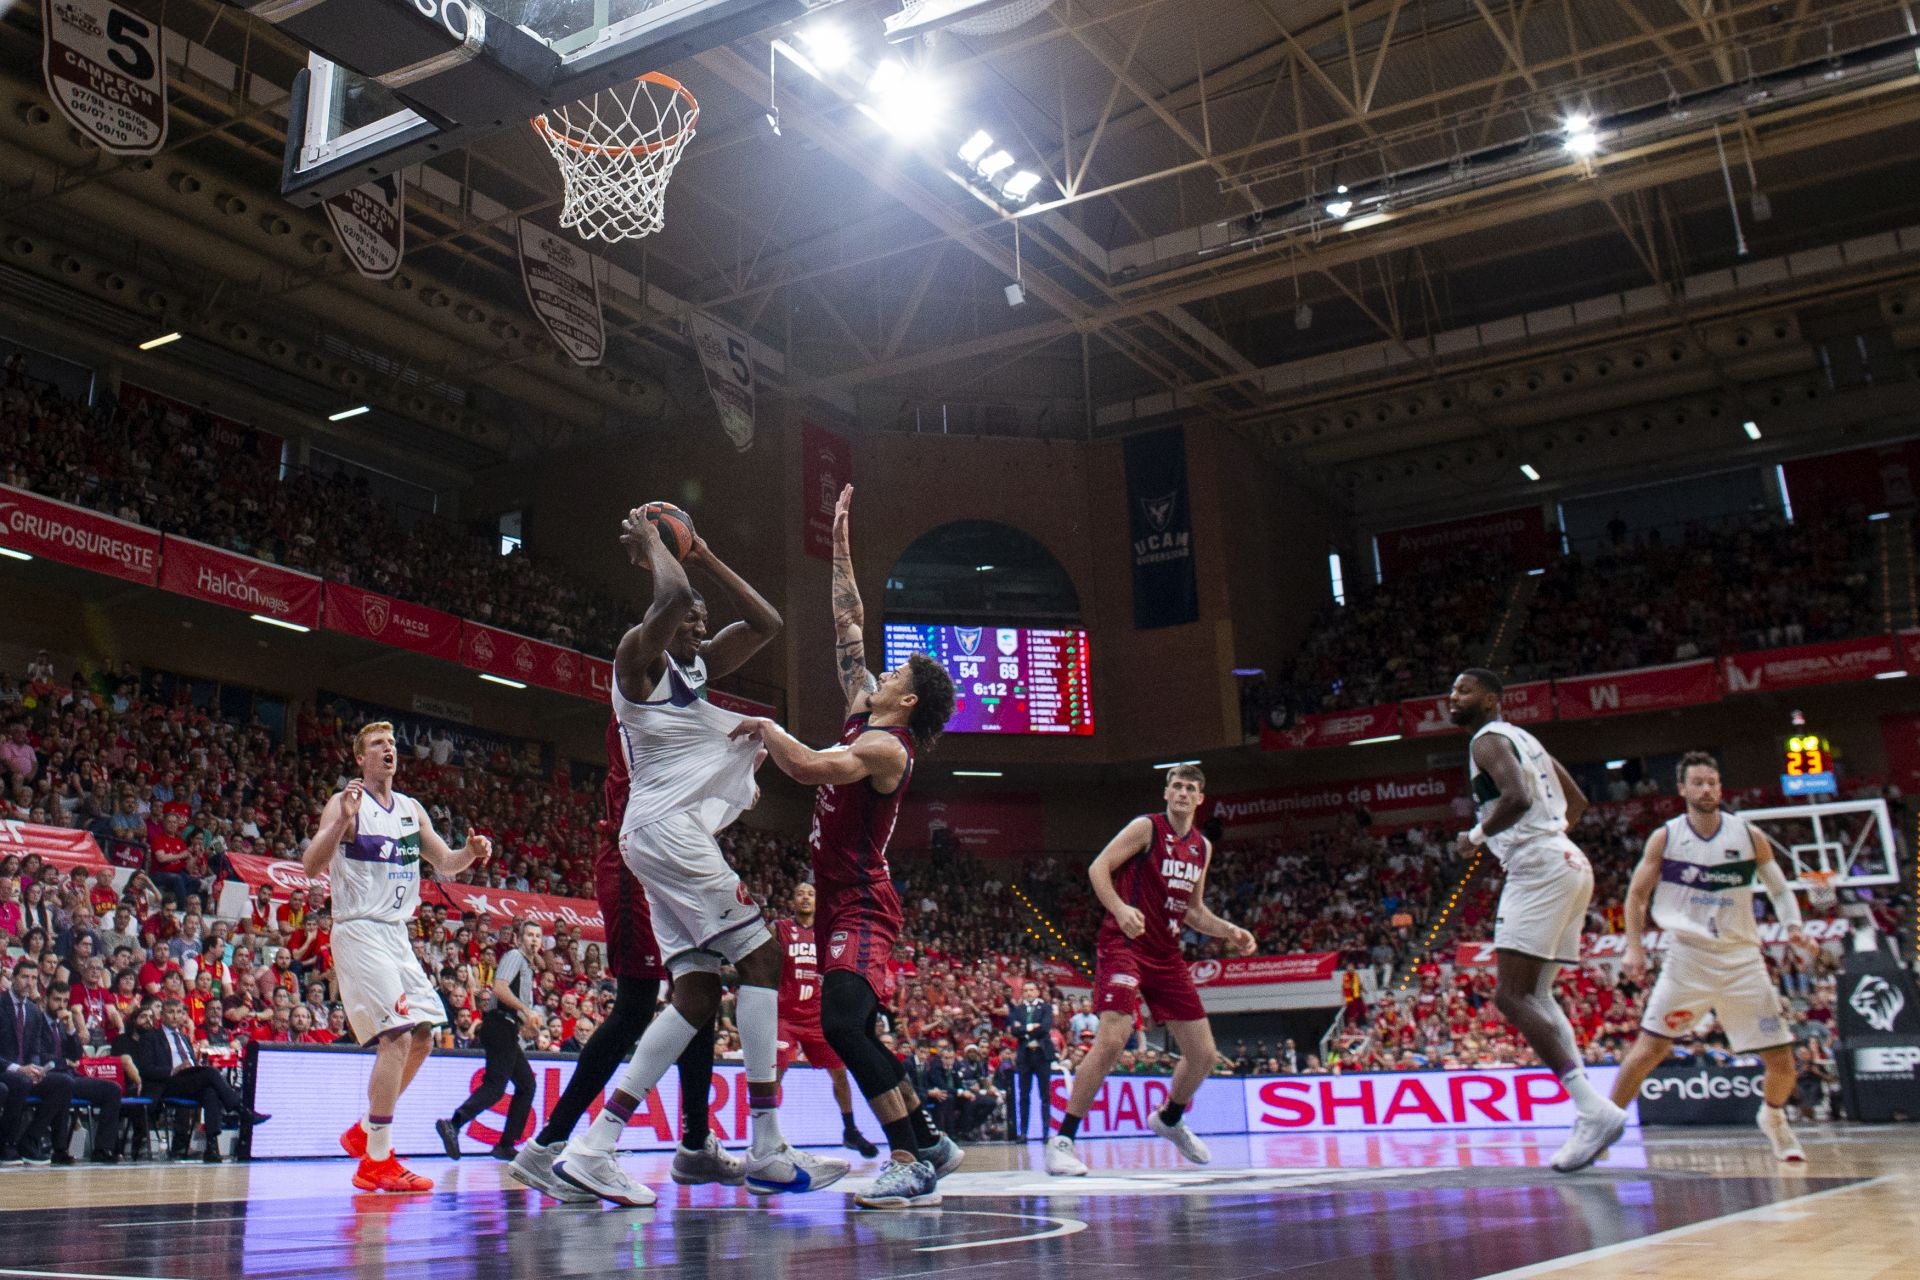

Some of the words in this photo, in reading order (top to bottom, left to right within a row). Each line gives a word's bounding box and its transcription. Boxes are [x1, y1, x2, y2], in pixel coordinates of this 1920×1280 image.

[107, 8, 155, 80] 5
[64, 51, 153, 106] CAMPEÓN
[90, 75, 132, 106] LIGA
[95, 121, 128, 142] 09/10
[344, 189, 395, 231] AMPEÓN
[352, 202, 384, 234] COPA
[727, 336, 750, 387] 5
[10, 511, 153, 569] GRUPOSURESTE
[1134, 531, 1190, 555] UCAM
[960, 662, 979, 678] 54
[999, 663, 1019, 679] 69
[973, 683, 1007, 696] 6:12
[1786, 750, 1823, 776] 23
[1213, 789, 1342, 820] Ayuntamiento
[1347, 785, 1371, 803] de
[1376, 777, 1447, 801] Murcia
[393, 886, 407, 909] 9
[788, 942, 817, 957] UCA
[1050, 1079, 1194, 1132] SHAR
[1258, 1072, 1571, 1128] SHARP
